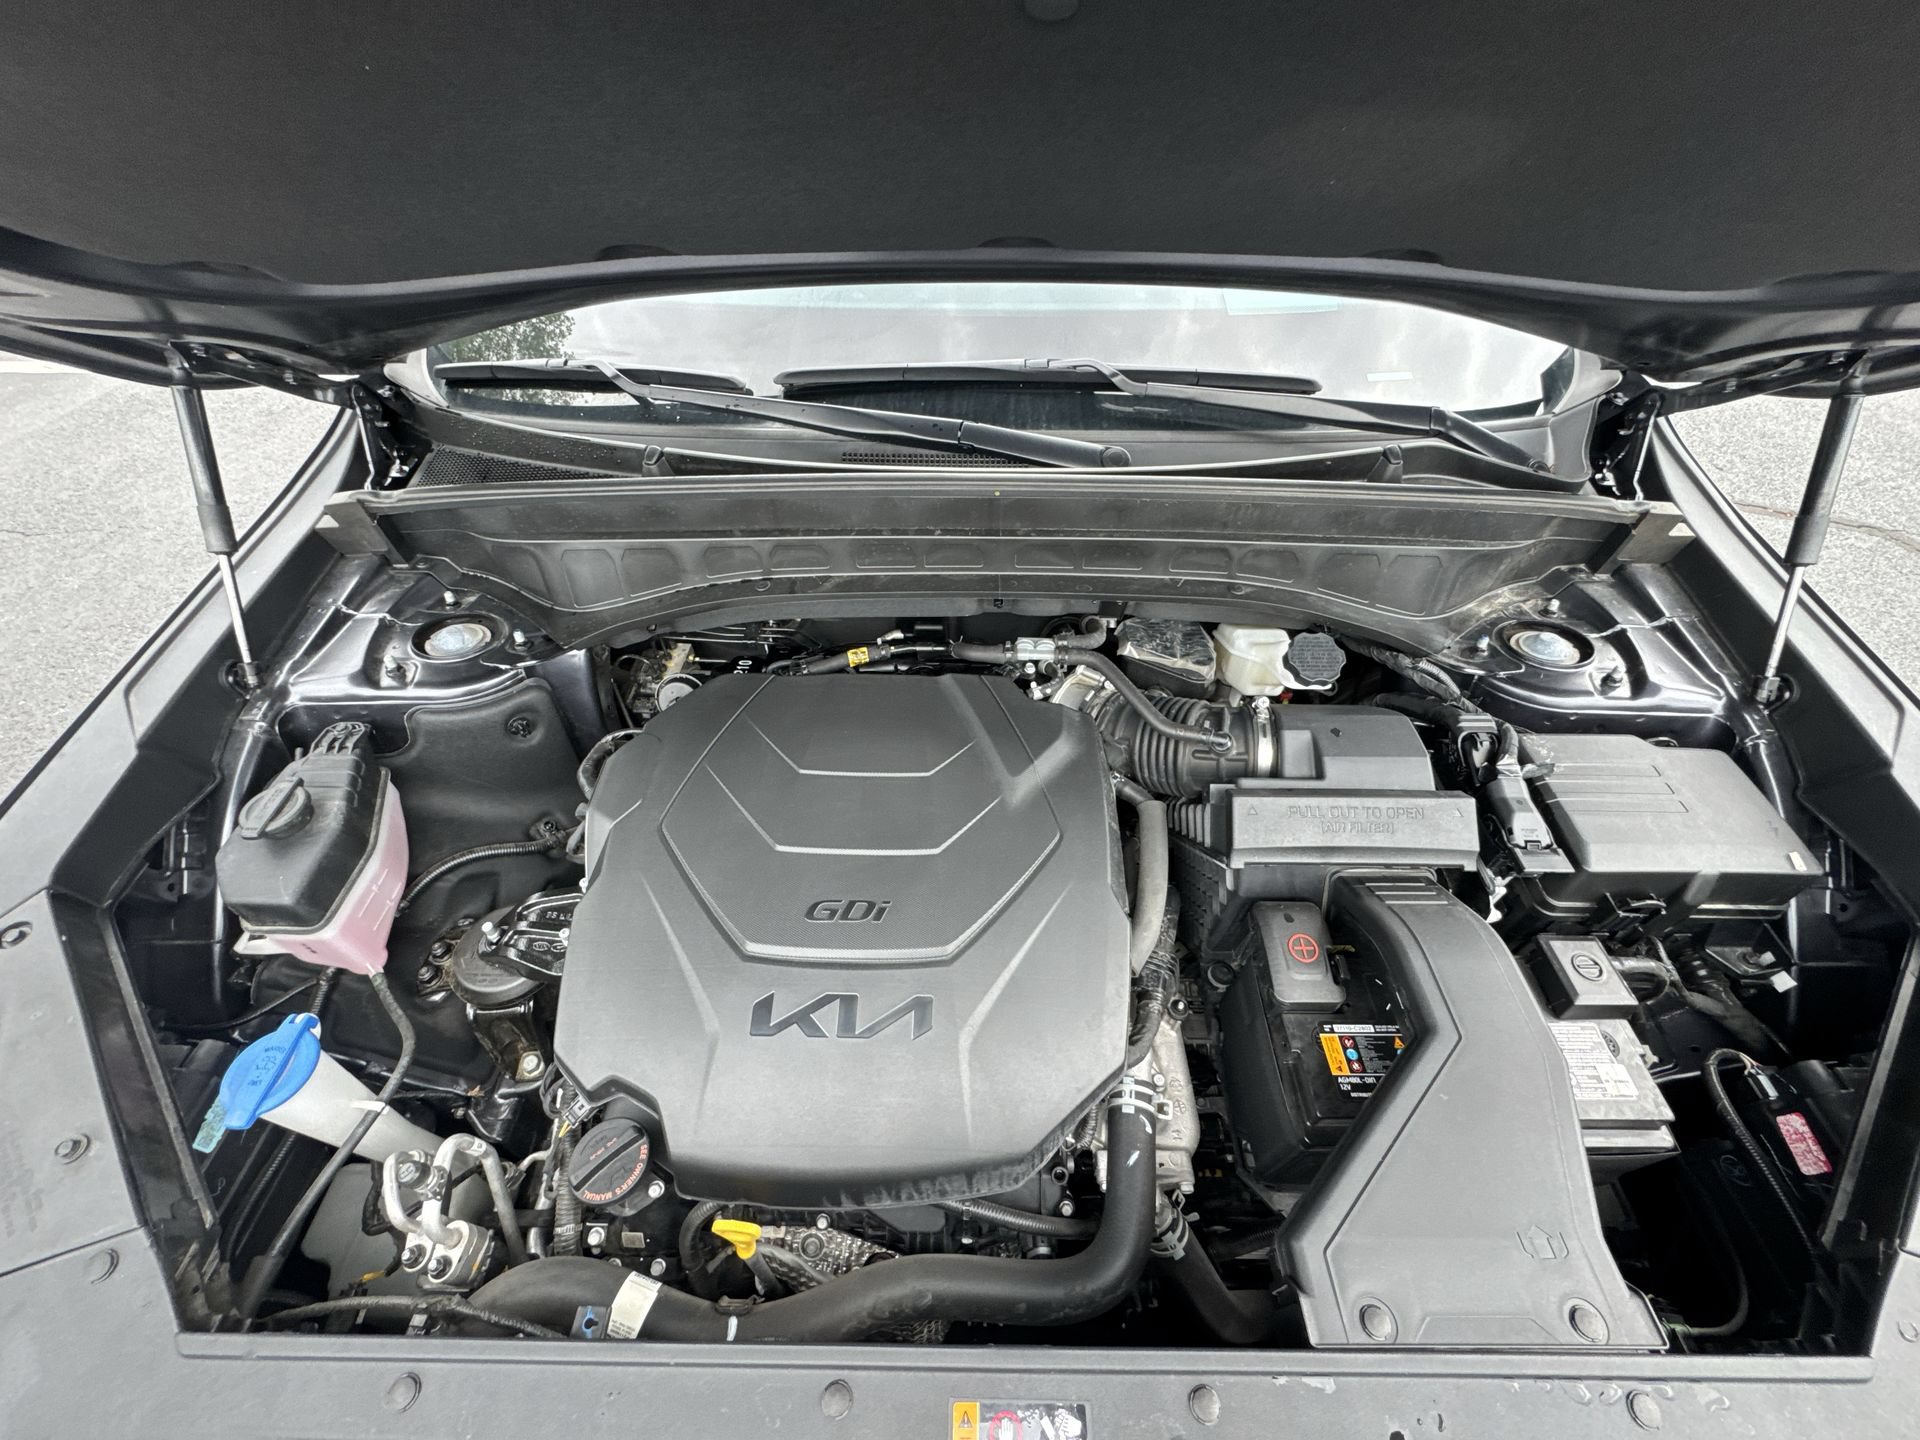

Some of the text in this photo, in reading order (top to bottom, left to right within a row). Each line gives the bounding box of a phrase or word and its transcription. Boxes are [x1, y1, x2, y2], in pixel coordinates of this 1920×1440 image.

[1288, 805, 1424, 820] PULL OUT TO OPEN
[804, 900, 892, 924] GDi
[750, 990, 934, 1041] KIA
[583, 1144, 648, 1201] SEE OWNER'S MANUAL
